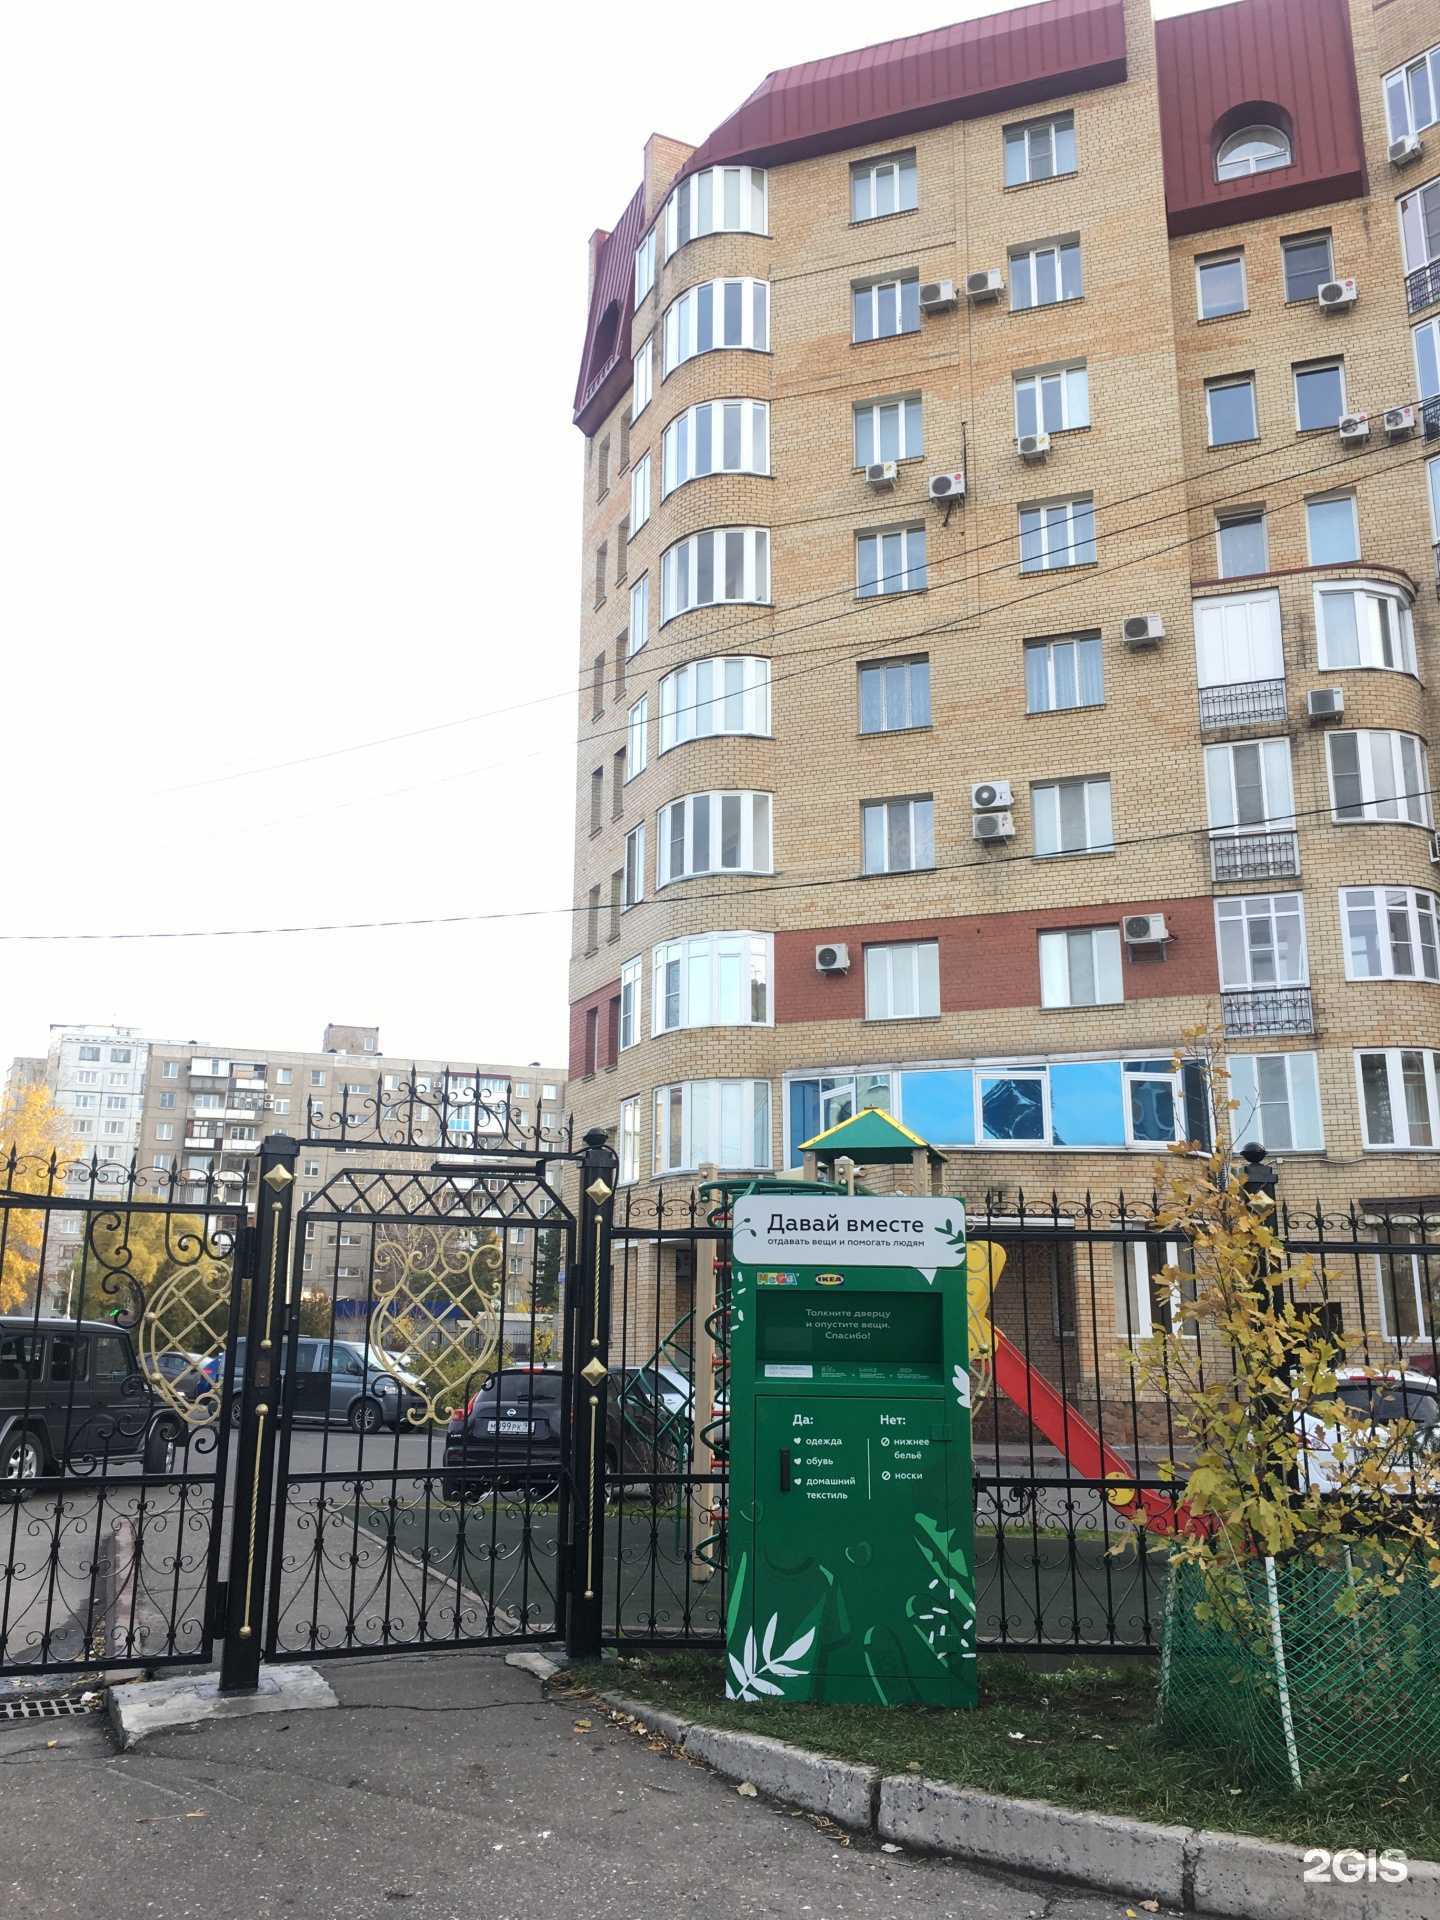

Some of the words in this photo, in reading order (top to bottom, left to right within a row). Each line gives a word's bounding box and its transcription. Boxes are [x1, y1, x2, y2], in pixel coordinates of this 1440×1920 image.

[767, 1213, 839, 1234] Давай
[846, 1218, 924, 1233] вместе
[767, 1238, 810, 1247] отдавать
[812, 1239, 837, 1247] вещи
[847, 1239, 890, 1247] помогать
[893, 1239, 925, 1248] людям
[817, 1275, 843, 1284] IKEA
[805, 1308, 851, 1317] Толкните
[854, 1311, 891, 1319] дверцу
[814, 1321, 859, 1329] опустите
[825, 1331, 871, 1340] Спасибо!
[793, 1414, 814, 1426] Да:
[880, 1414, 906, 1425] Нет:
[805, 1437, 843, 1446] одежда
[893, 1437, 930, 1446] нижнее
[894, 1450, 922, 1460] бельё
[806, 1456, 834, 1467] обувь
[894, 1471, 923, 1480] носки
[806, 1476, 856, 1486] домашний
[806, 1491, 848, 1500] текстиль
